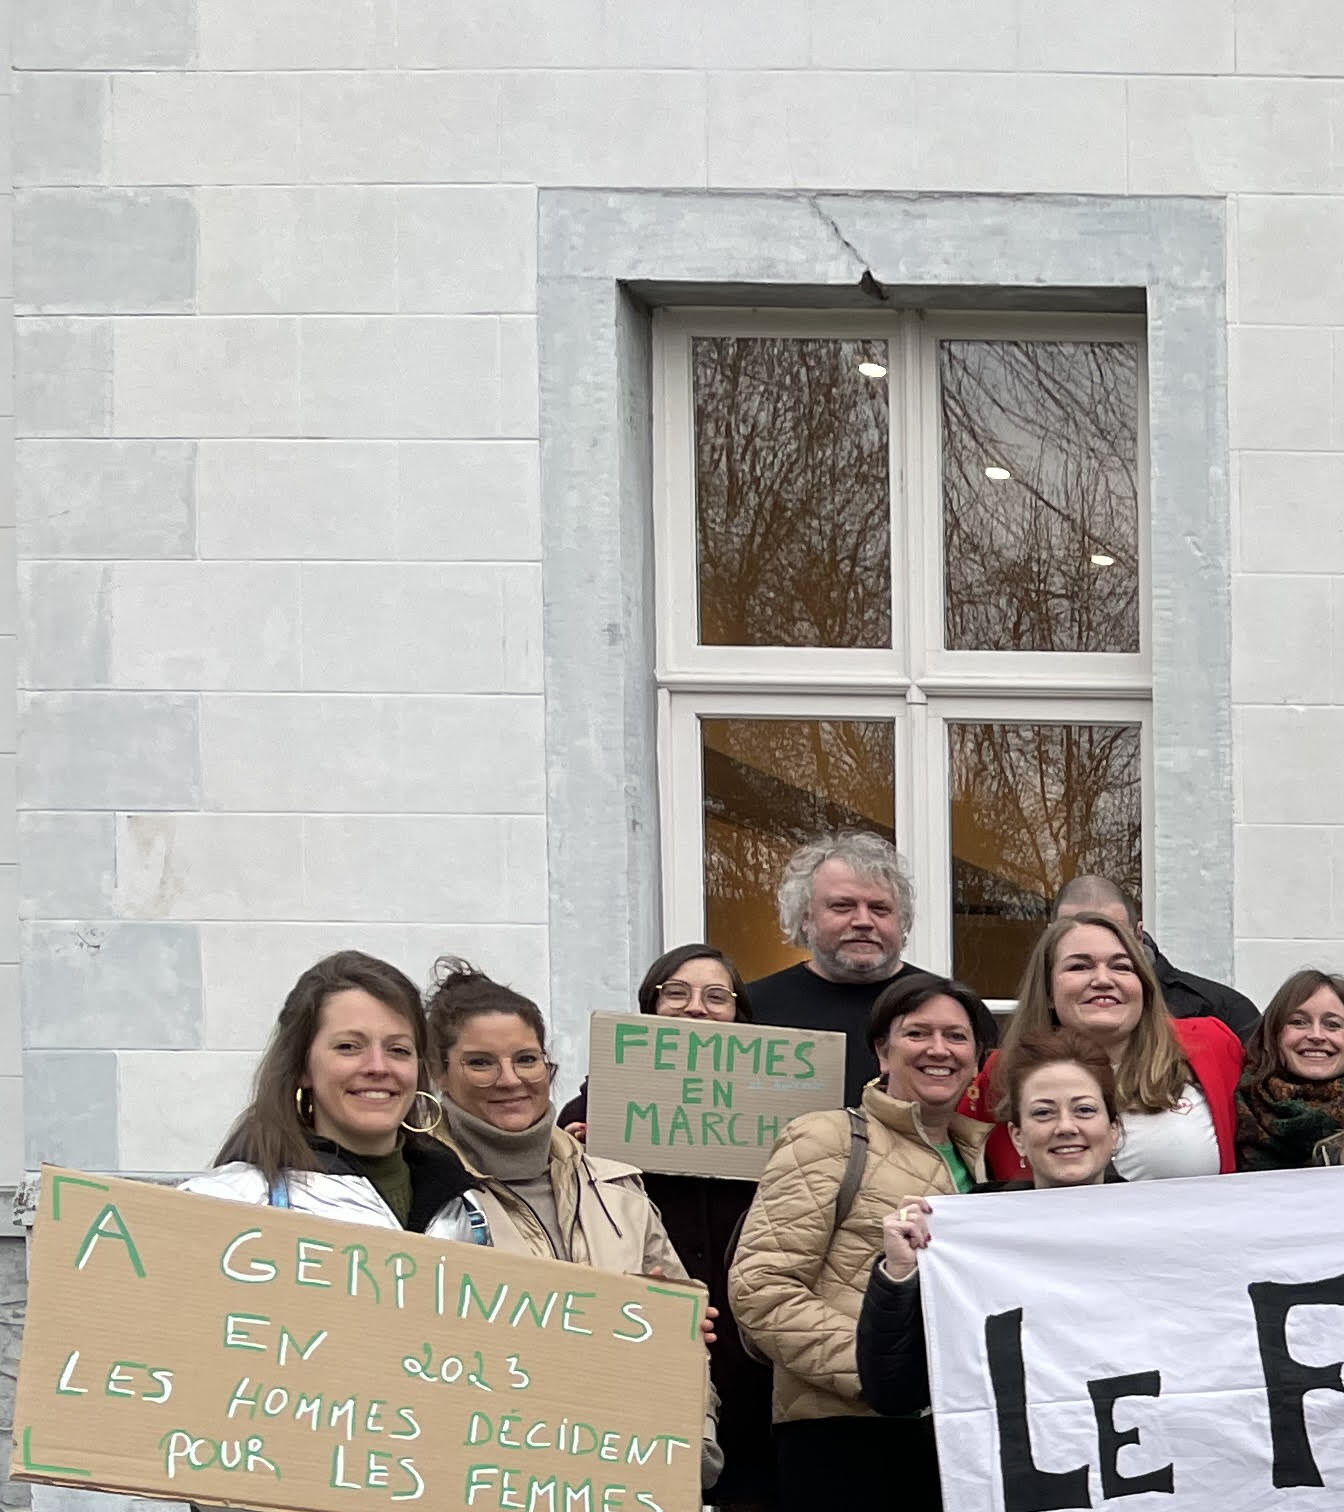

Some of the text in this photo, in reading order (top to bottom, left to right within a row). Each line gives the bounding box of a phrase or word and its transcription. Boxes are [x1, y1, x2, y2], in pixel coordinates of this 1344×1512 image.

[615, 1023, 816, 1079] FEMMES
[624, 1100, 793, 1146] MARCH
[681, 1078, 734, 1109] EN
[75, 1203, 147, 1278] A
[223, 1312, 532, 1391] EN 2023
[55, 1350, 174, 1404] LES
[226, 1377, 422, 1441] HOMMES
[158, 1428, 282, 1480] POUR
[329, 1445, 425, 1501] LES
